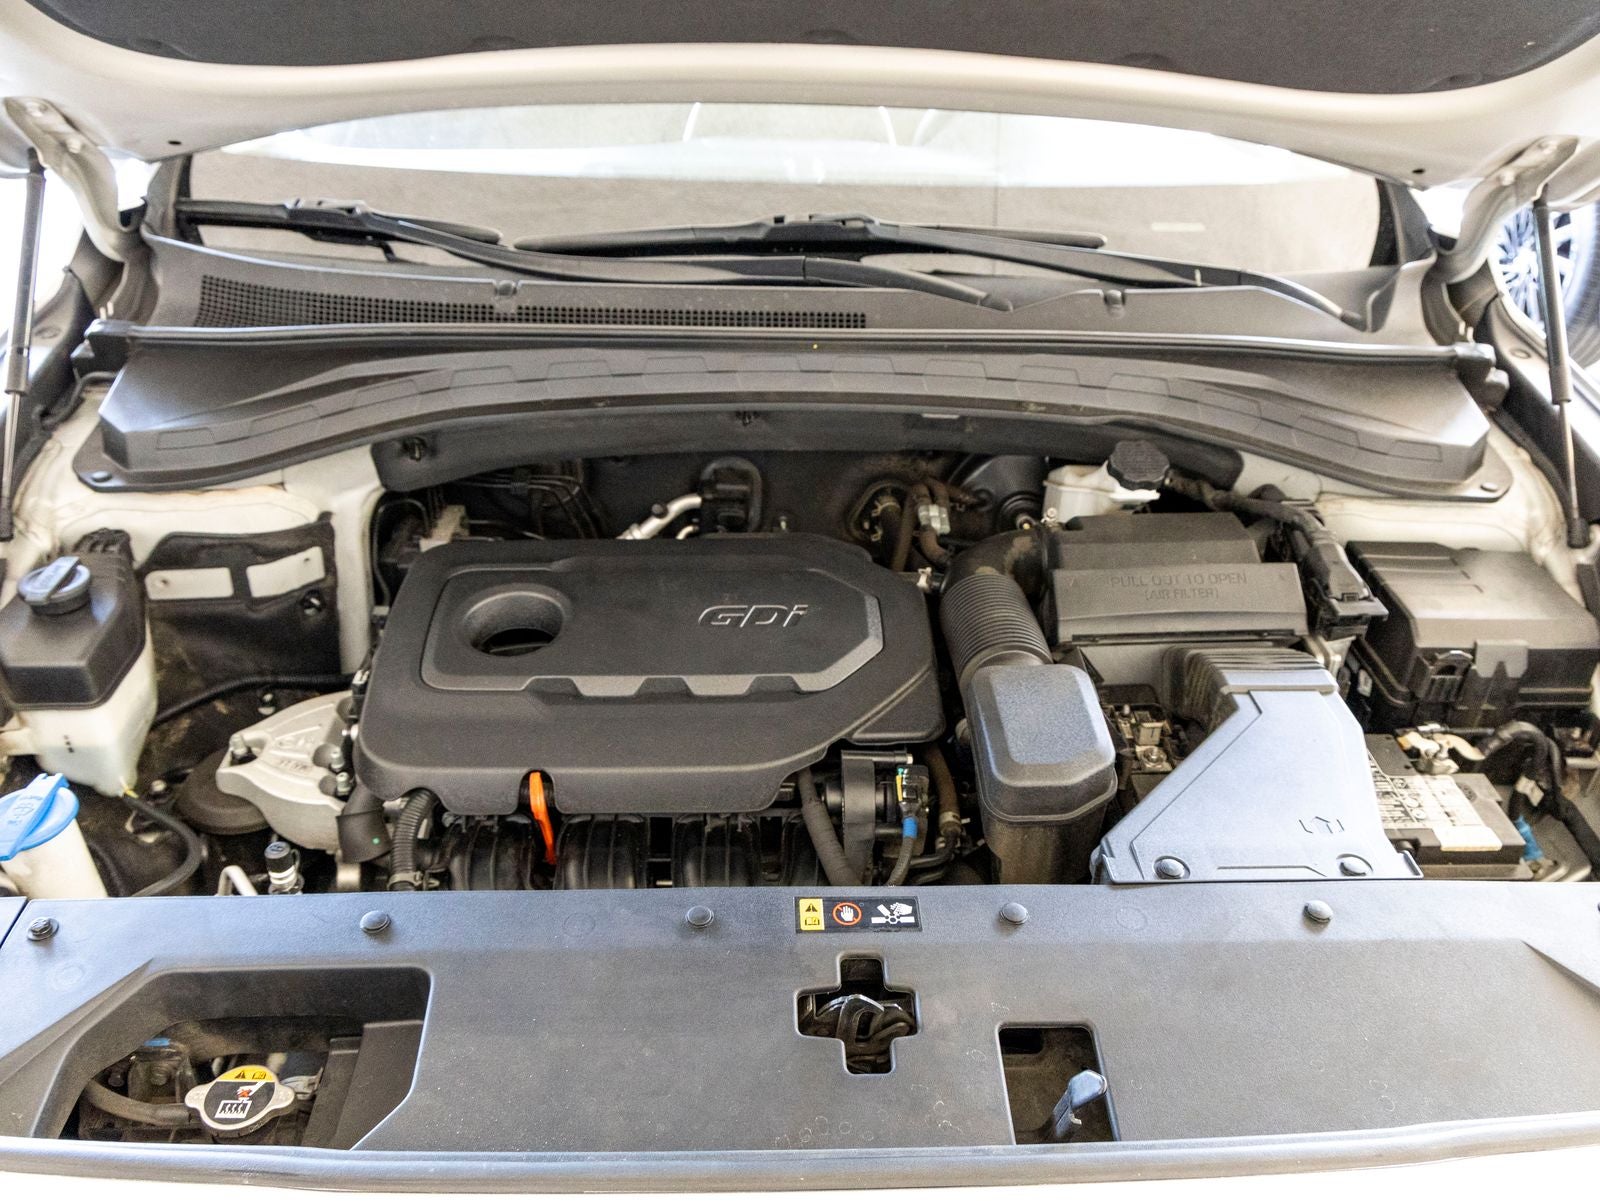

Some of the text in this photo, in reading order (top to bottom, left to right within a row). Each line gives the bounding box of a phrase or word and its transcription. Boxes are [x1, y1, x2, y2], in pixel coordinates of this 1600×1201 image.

[1110, 573, 1149, 588] PULL
[1184, 571, 1204, 585] TO
[1207, 571, 1248, 586] OPEN
[1173, 587, 1220, 600] FILTER)
